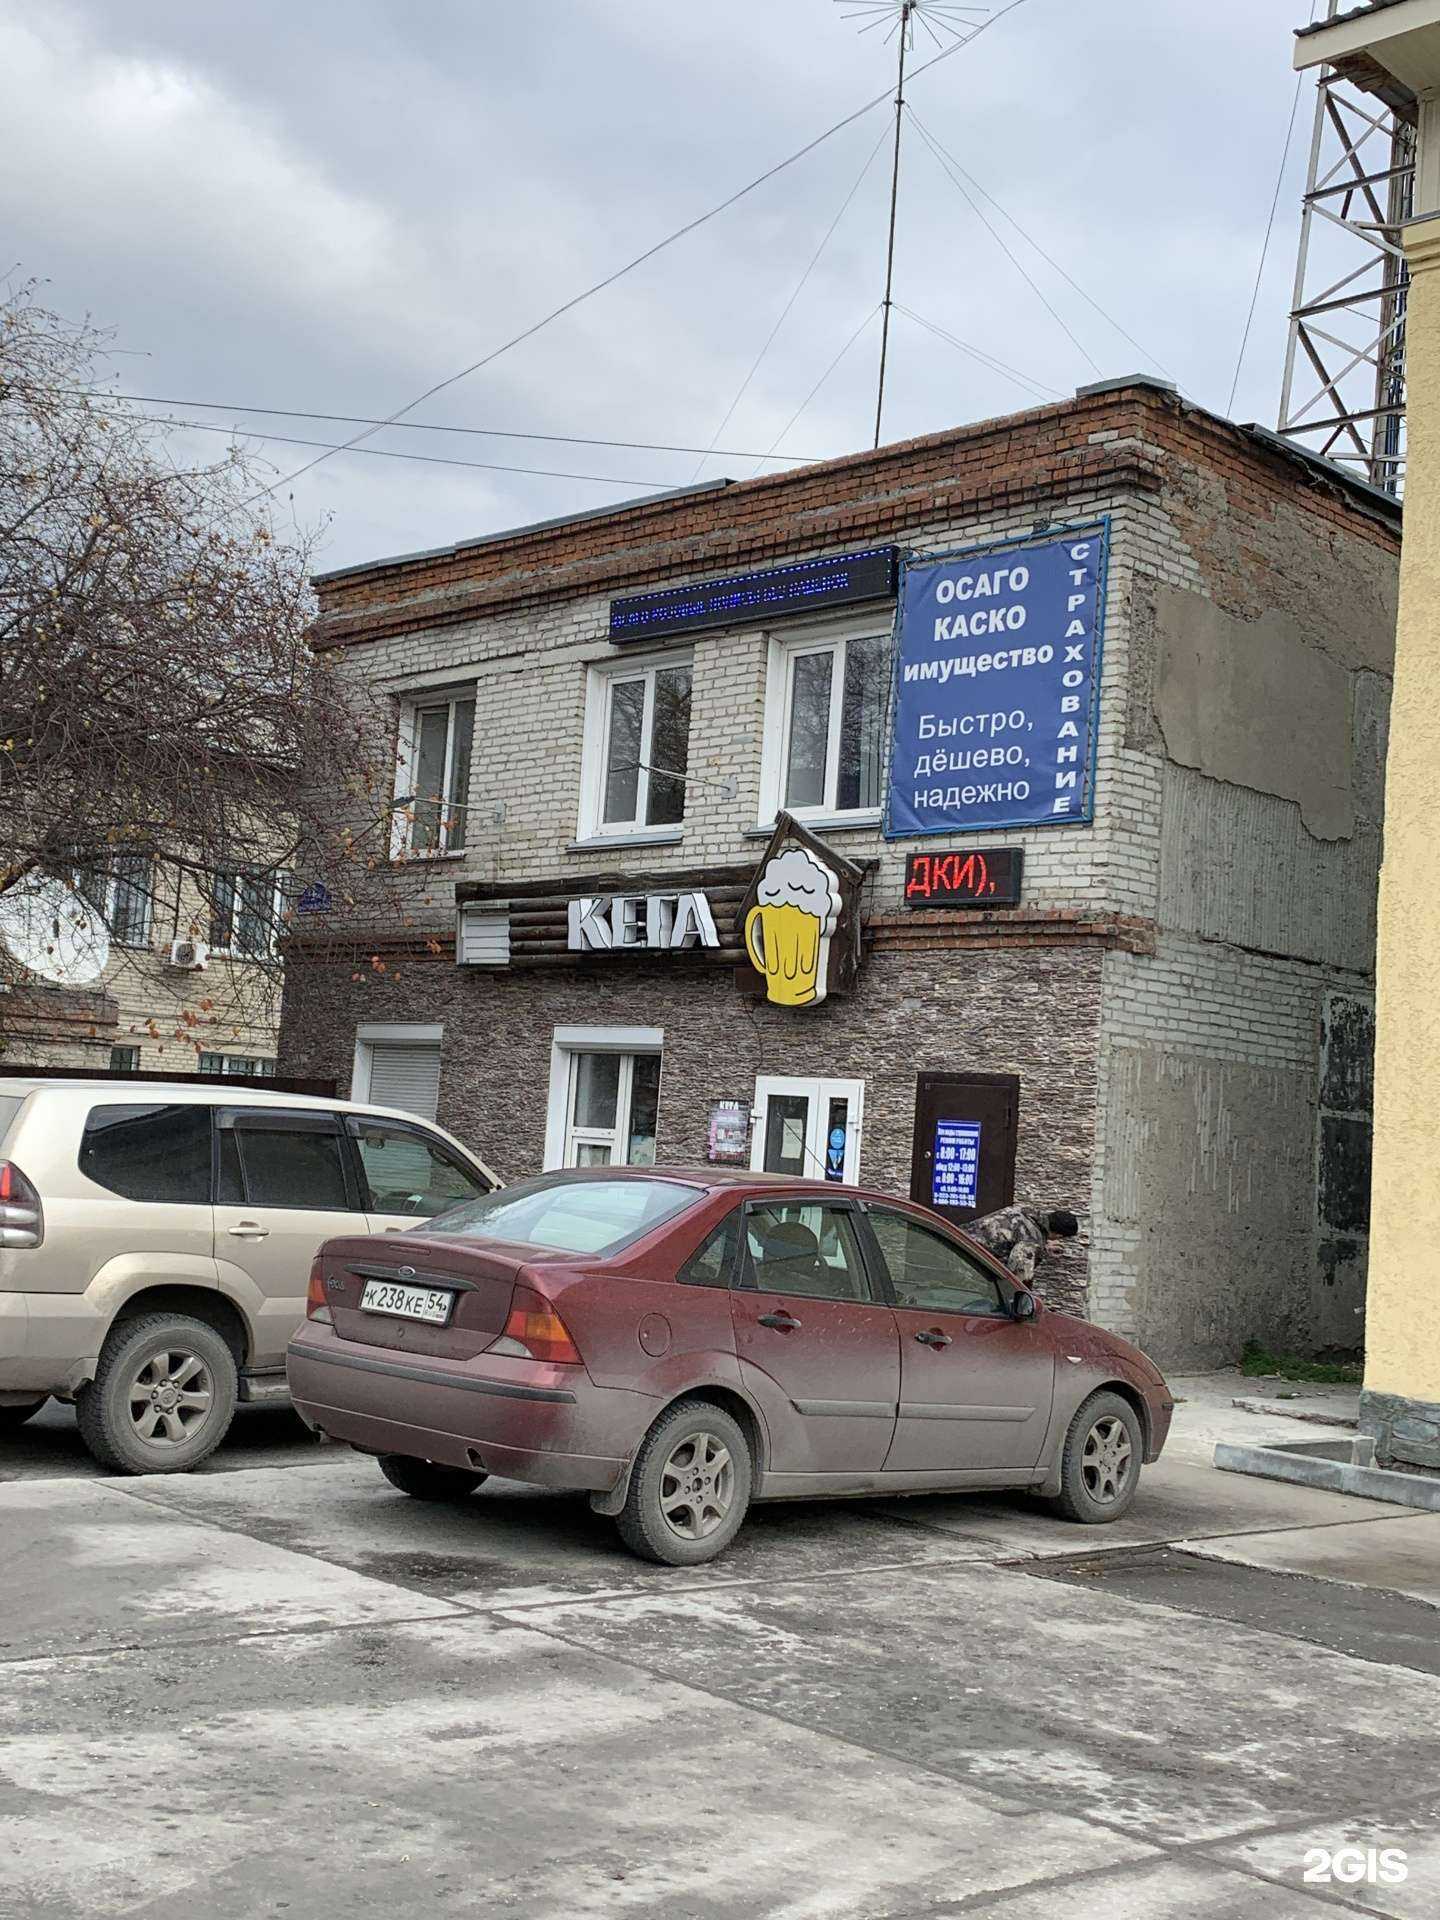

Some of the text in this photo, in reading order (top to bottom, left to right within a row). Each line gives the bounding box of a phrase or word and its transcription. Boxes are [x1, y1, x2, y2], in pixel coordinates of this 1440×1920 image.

[936, 567, 1030, 604] ОСАГО
[934, 605, 1026, 641] КАСКО
[904, 645, 1054, 683] имущество
[1053, 543, 1090, 813] СТРАХОВАНИЕ
[918, 710, 1033, 739] Быстро,
[914, 746, 1030, 778] дёшево,
[914, 780, 1030, 811] надежно
[907, 855, 996, 897] ДКИ),
[428, 1292, 443, 1311] 54
